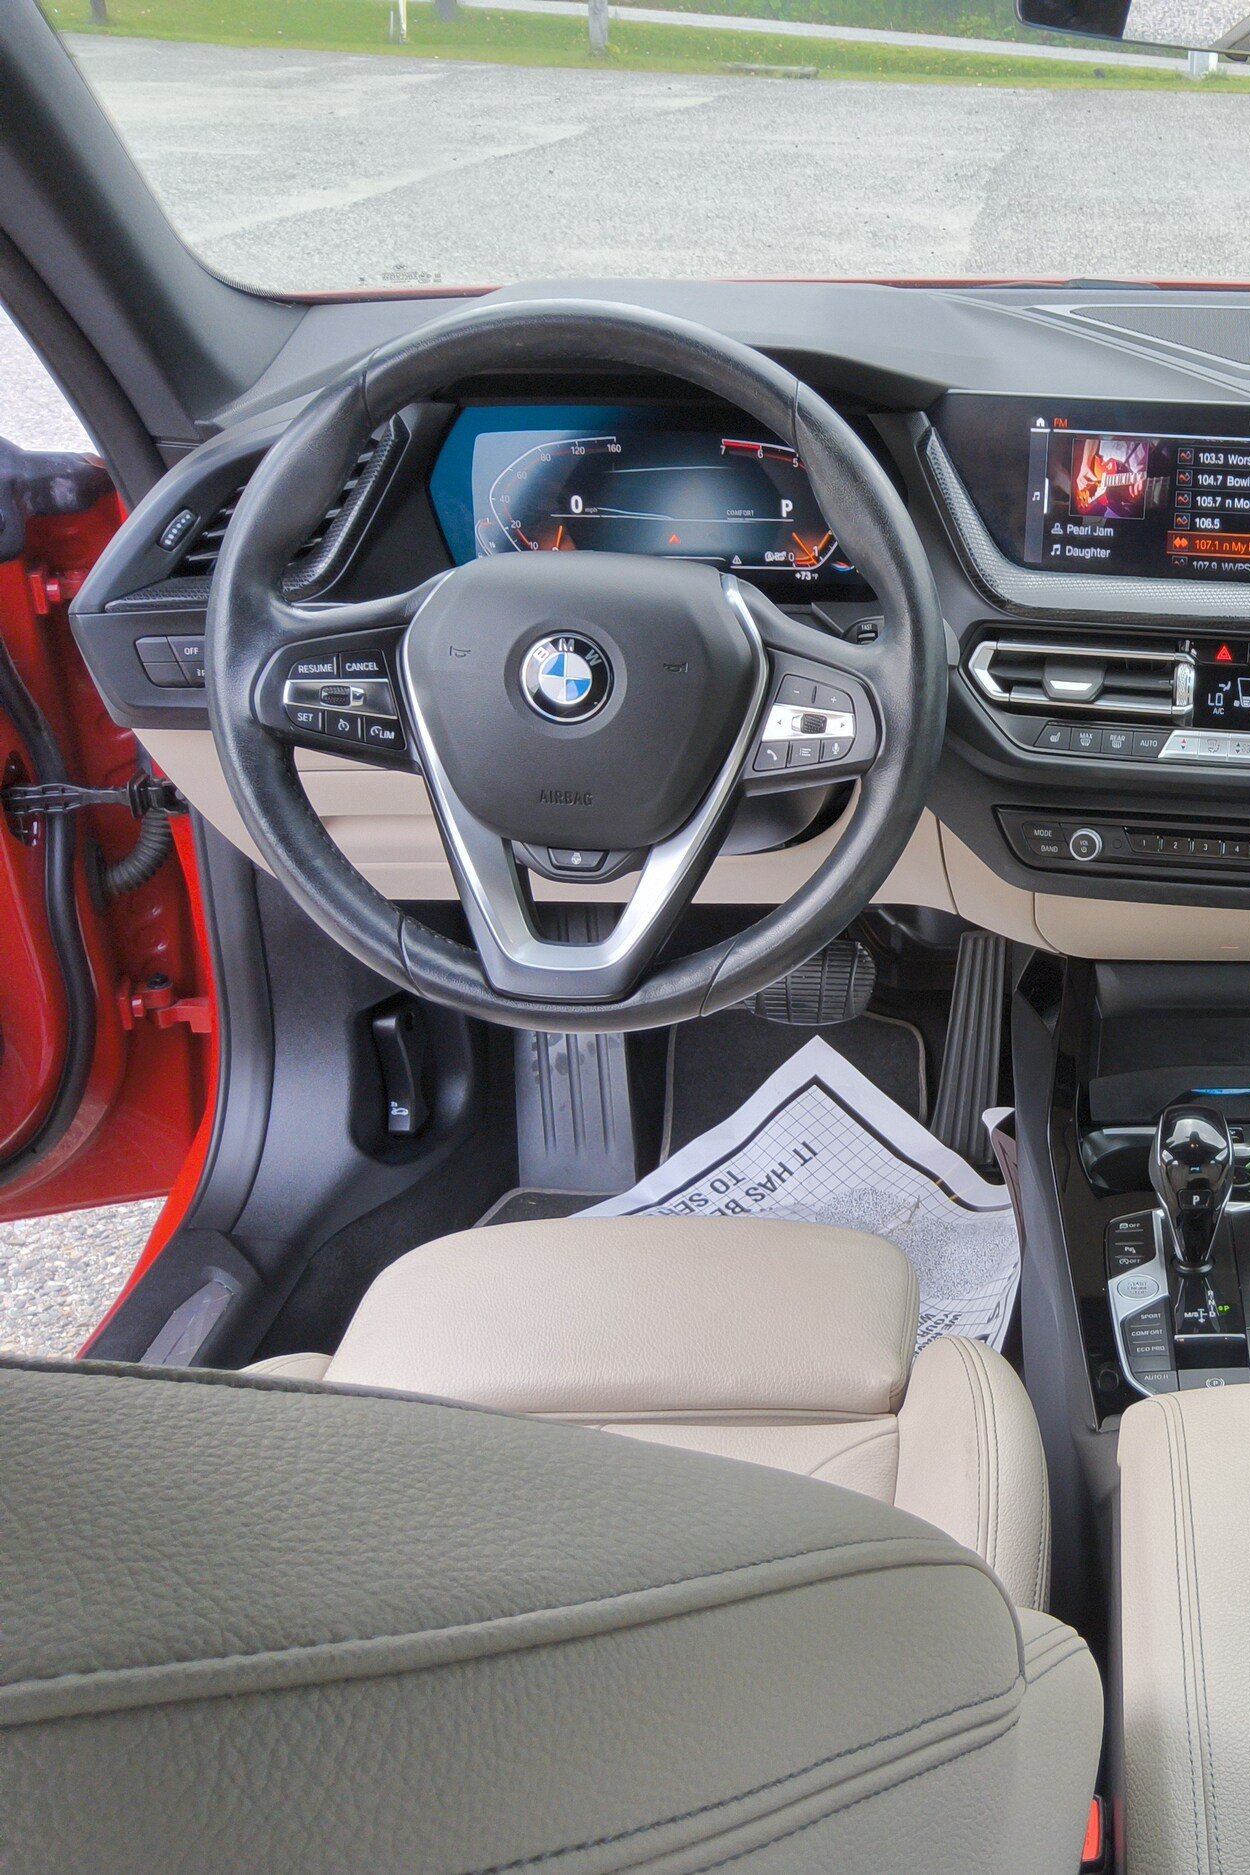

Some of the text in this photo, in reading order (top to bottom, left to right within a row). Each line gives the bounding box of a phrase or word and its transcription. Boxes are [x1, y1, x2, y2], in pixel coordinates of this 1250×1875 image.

[1053, 418, 1068, 428] FM
[571, 446, 586, 455] 120
[606, 444, 622, 454] 160
[540, 453, 551, 462] 80
[792, 457, 799, 468] 5
[1199, 453, 1224, 465] 103.3
[516, 471, 527, 480] 60
[1197, 474, 1222, 486] 104.7
[500, 496, 511, 504] 40
[570, 495, 583, 514] 0
[1196, 496, 1221, 508] 105.7
[726, 509, 754, 517] COMFORT
[781, 499, 794, 518] P
[511, 519, 522, 529] 20
[1195, 518, 1220, 529] 106.5
[1066, 524, 1114, 537] Pearl Jam
[529, 541, 539, 550] 10
[1195, 540, 1219, 551] 107.1
[1232, 542, 1246, 554] My
[1065, 545, 1111, 559] Daughter
[1193, 561, 1218, 571] 107.9
[184, 647, 200, 656] OFF
[533, 637, 602, 667] BMW
[298, 663, 333, 673] RESUME
[345, 662, 379, 672] CANCEL
[1207, 692, 1224, 706] LO
[1212, 707, 1225, 715] A/C
[297, 712, 314, 722] SET
[379, 730, 395, 740] LIM
[1140, 739, 1158, 747] AUTO
[539, 789, 593, 807] AIRBAG
[1034, 829, 1053, 838] MODE
[1040, 844, 1059, 853] BAND
[793, 1140, 818, 1167] IT
[710, 1169, 746, 1195] TO
[745, 1161, 794, 1201] HAS
[1192, 1195, 1200, 1206] P
[1140, 1312, 1161, 1320] SPORT
[1131, 1329, 1163, 1337] COMFORT
